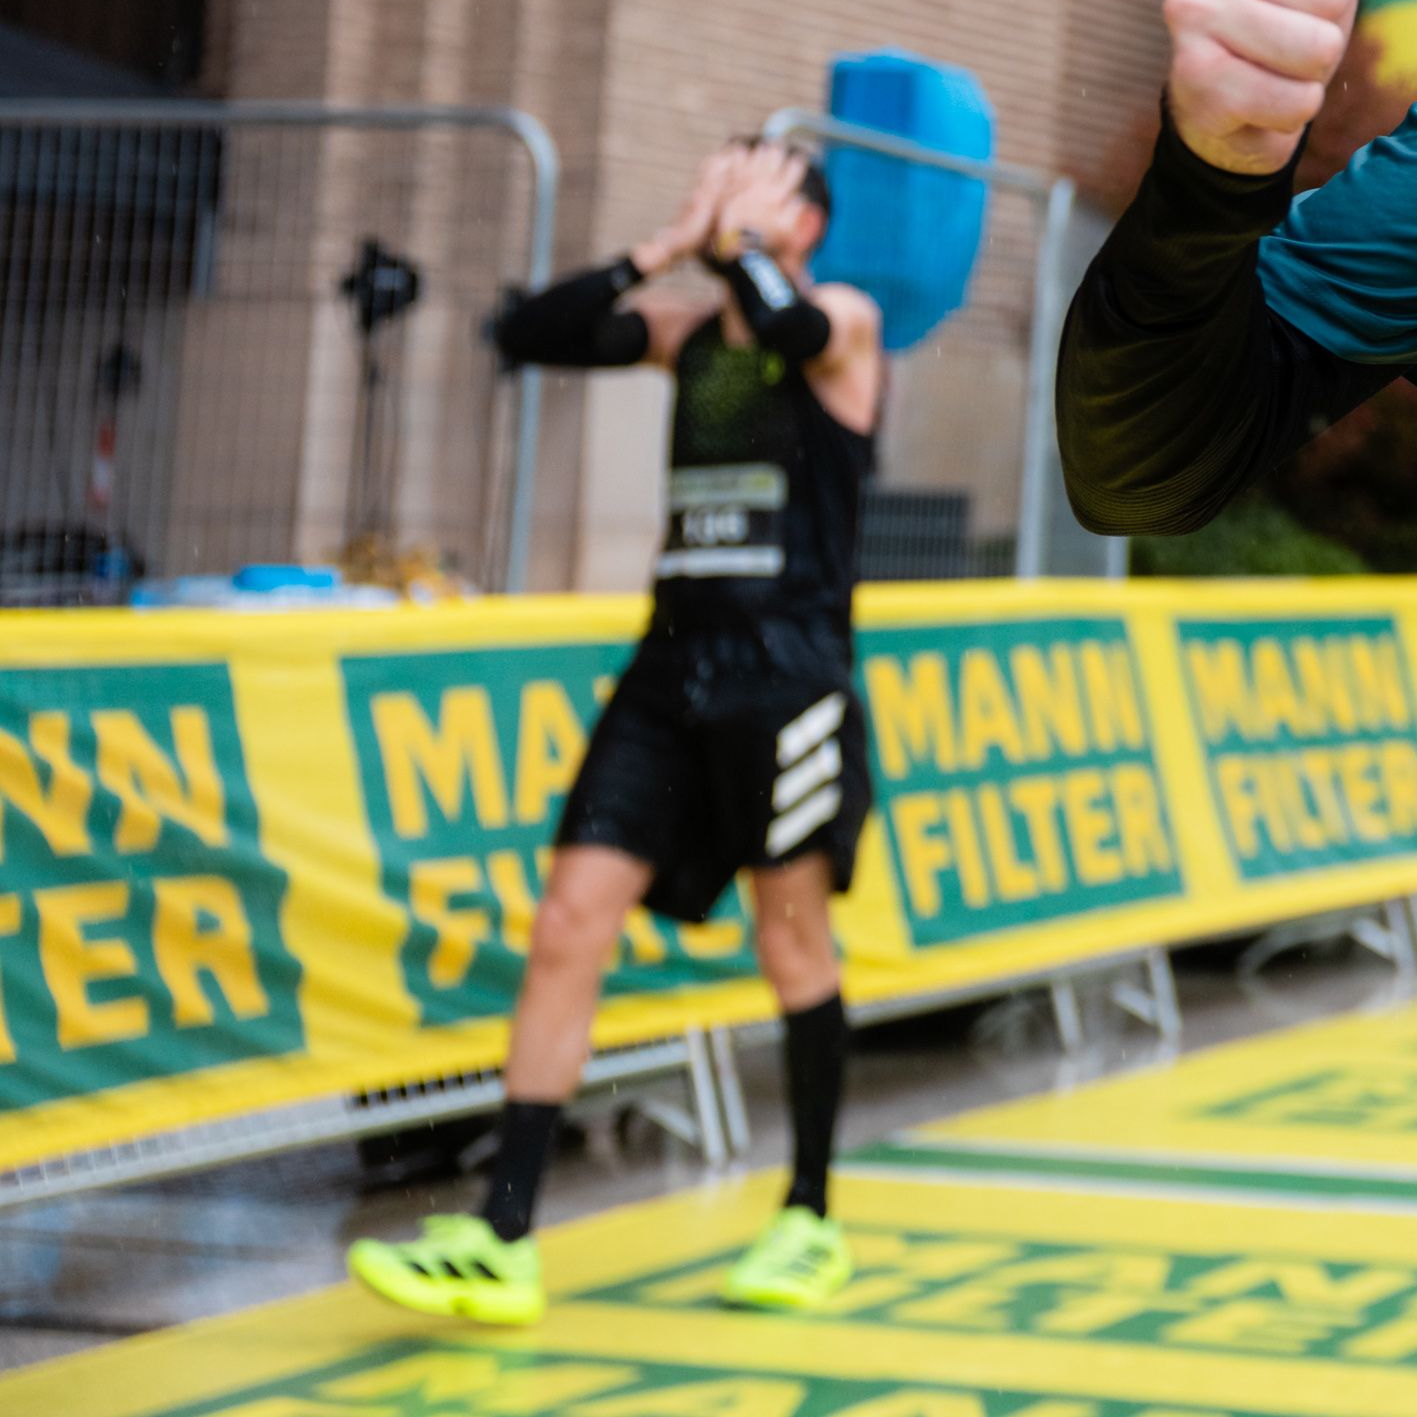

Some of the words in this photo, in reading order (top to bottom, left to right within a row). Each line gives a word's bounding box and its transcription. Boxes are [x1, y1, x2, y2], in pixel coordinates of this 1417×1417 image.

[862, 640, 1147, 780] MANN
[1182, 632, 1411, 748] MANN
[890, 763, 1174, 919] FILTER
